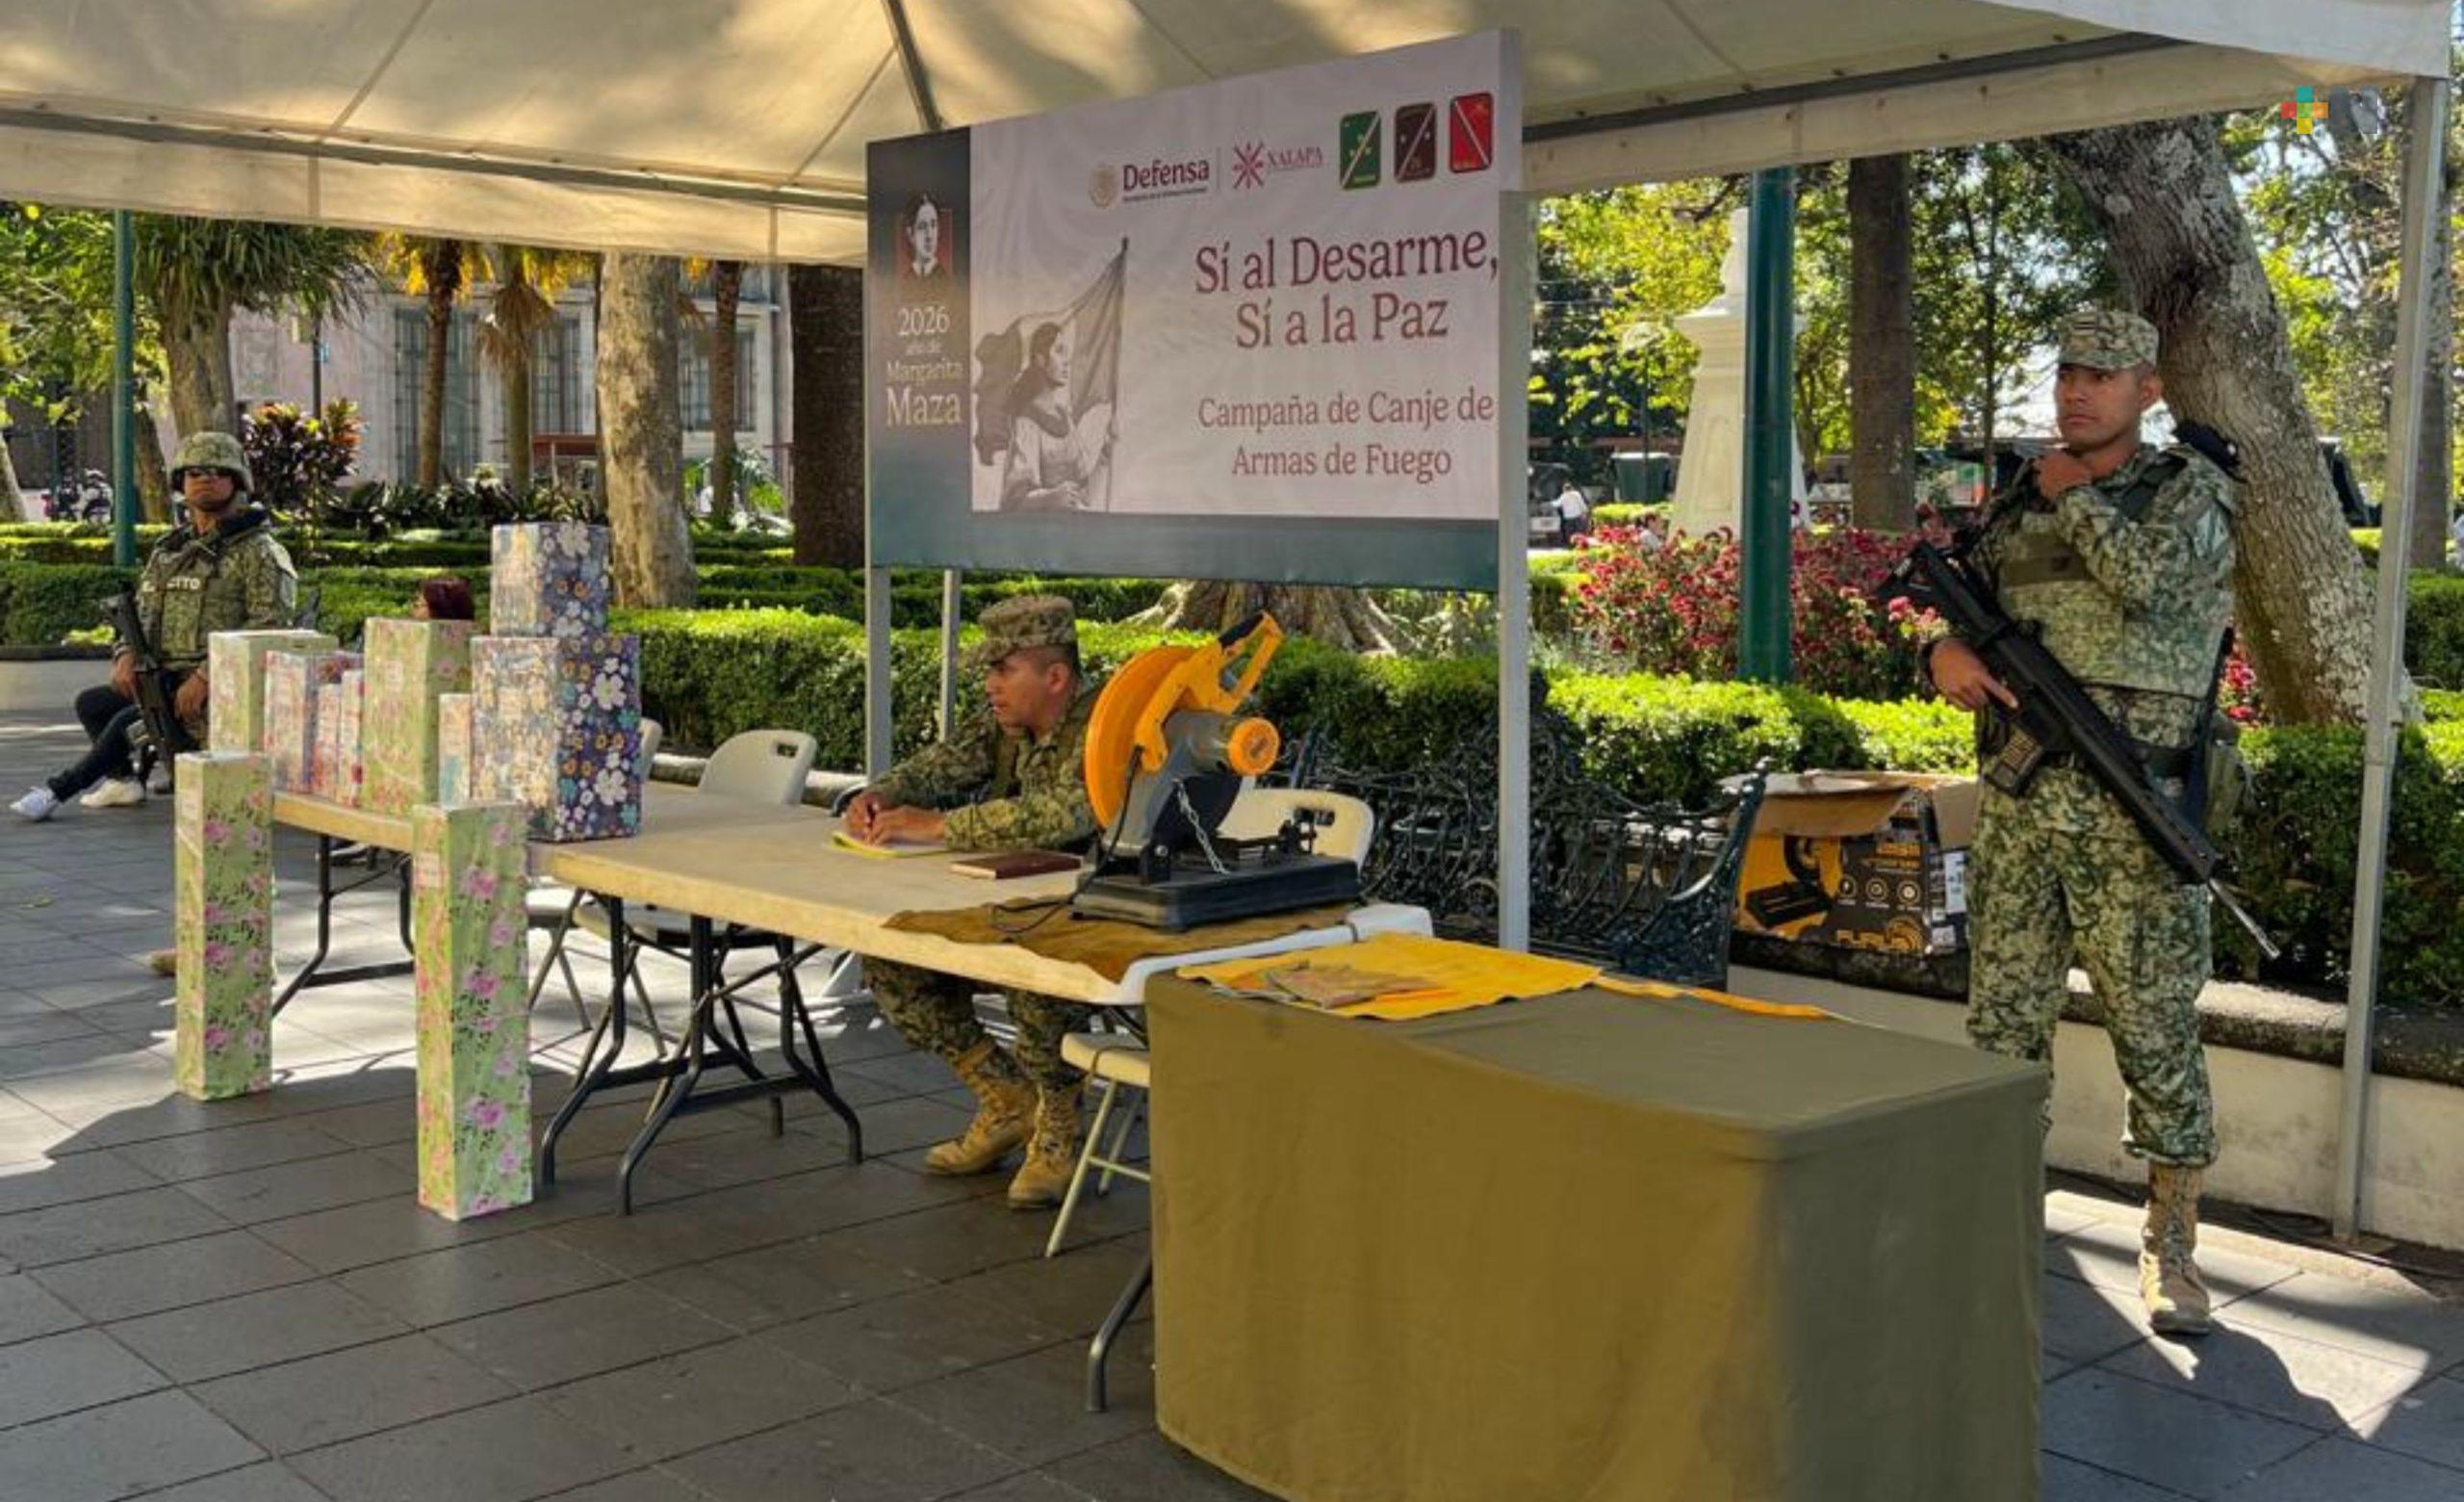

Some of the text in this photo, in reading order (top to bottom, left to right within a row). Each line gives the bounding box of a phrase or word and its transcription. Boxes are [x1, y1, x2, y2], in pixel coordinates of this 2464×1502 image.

[1122, 159, 1210, 192] Defensa
[1195, 230, 1499, 294] Sí al Desarme,
[896, 306, 951, 335] 2026
[1236, 292, 1449, 349] Sí a la Paz
[886, 357, 962, 385] Margarita
[886, 386, 962, 426] Maza
[1198, 386, 1495, 433] Campaña de Canje de
[1232, 443, 1451, 483] Armas de Fuego
